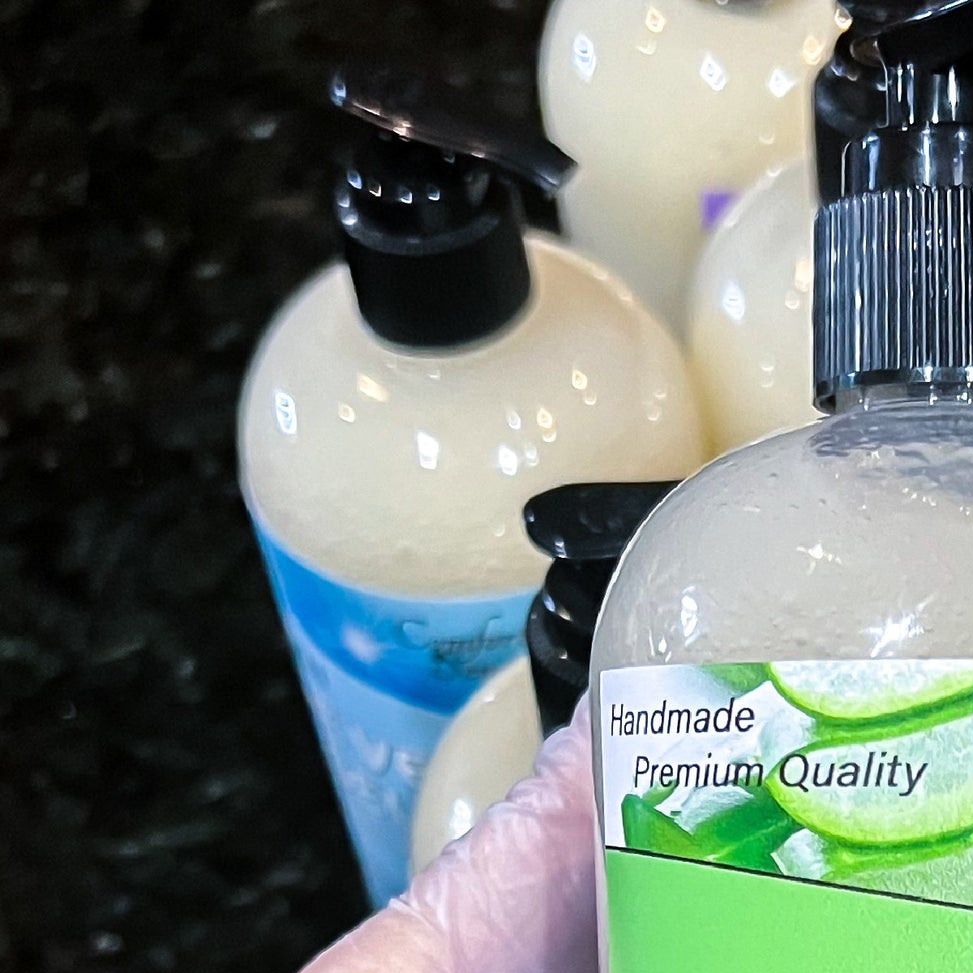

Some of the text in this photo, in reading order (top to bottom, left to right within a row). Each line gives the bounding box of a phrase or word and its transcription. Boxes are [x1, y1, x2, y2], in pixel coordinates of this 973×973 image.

[610, 697, 755, 737] Handmade
[633, 751, 929, 797] Premium Quality
